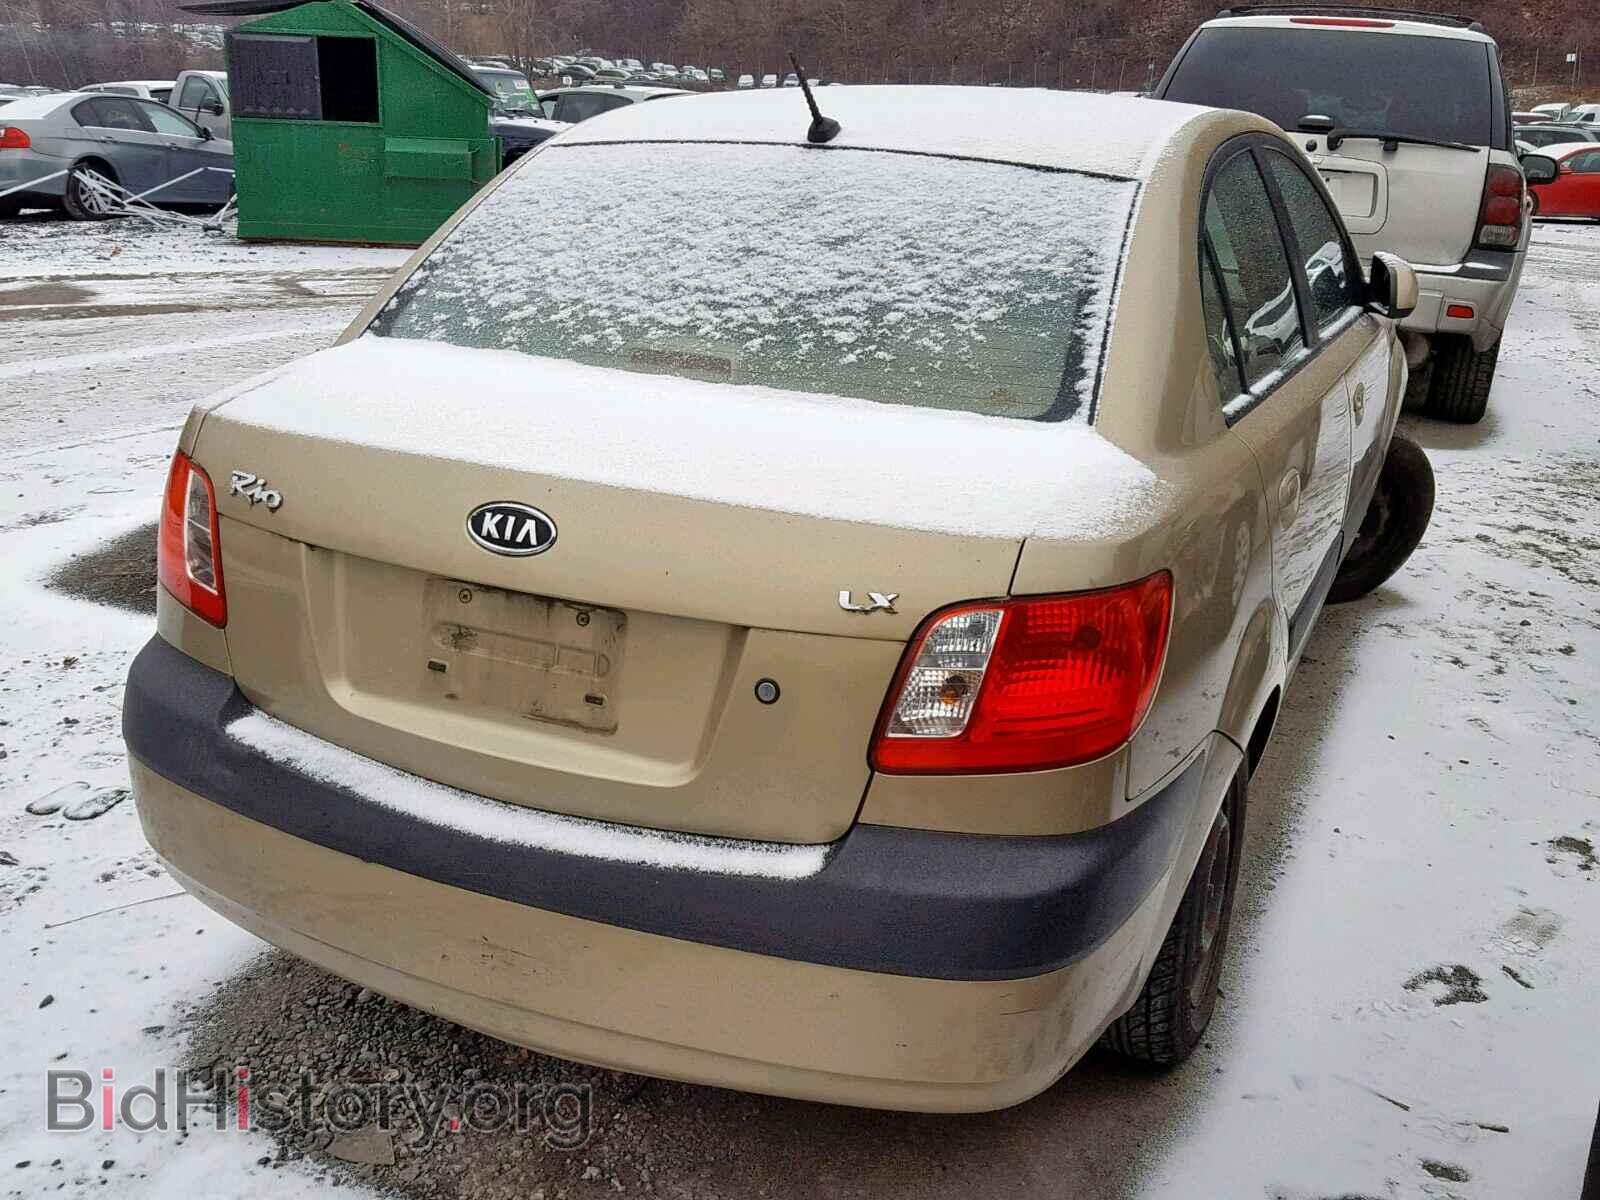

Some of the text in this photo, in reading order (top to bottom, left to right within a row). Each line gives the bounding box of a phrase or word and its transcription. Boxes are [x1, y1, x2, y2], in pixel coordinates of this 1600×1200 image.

[227, 470, 283, 510] Rio
[481, 512, 537, 545] KIA
[839, 590, 899, 612] LX
